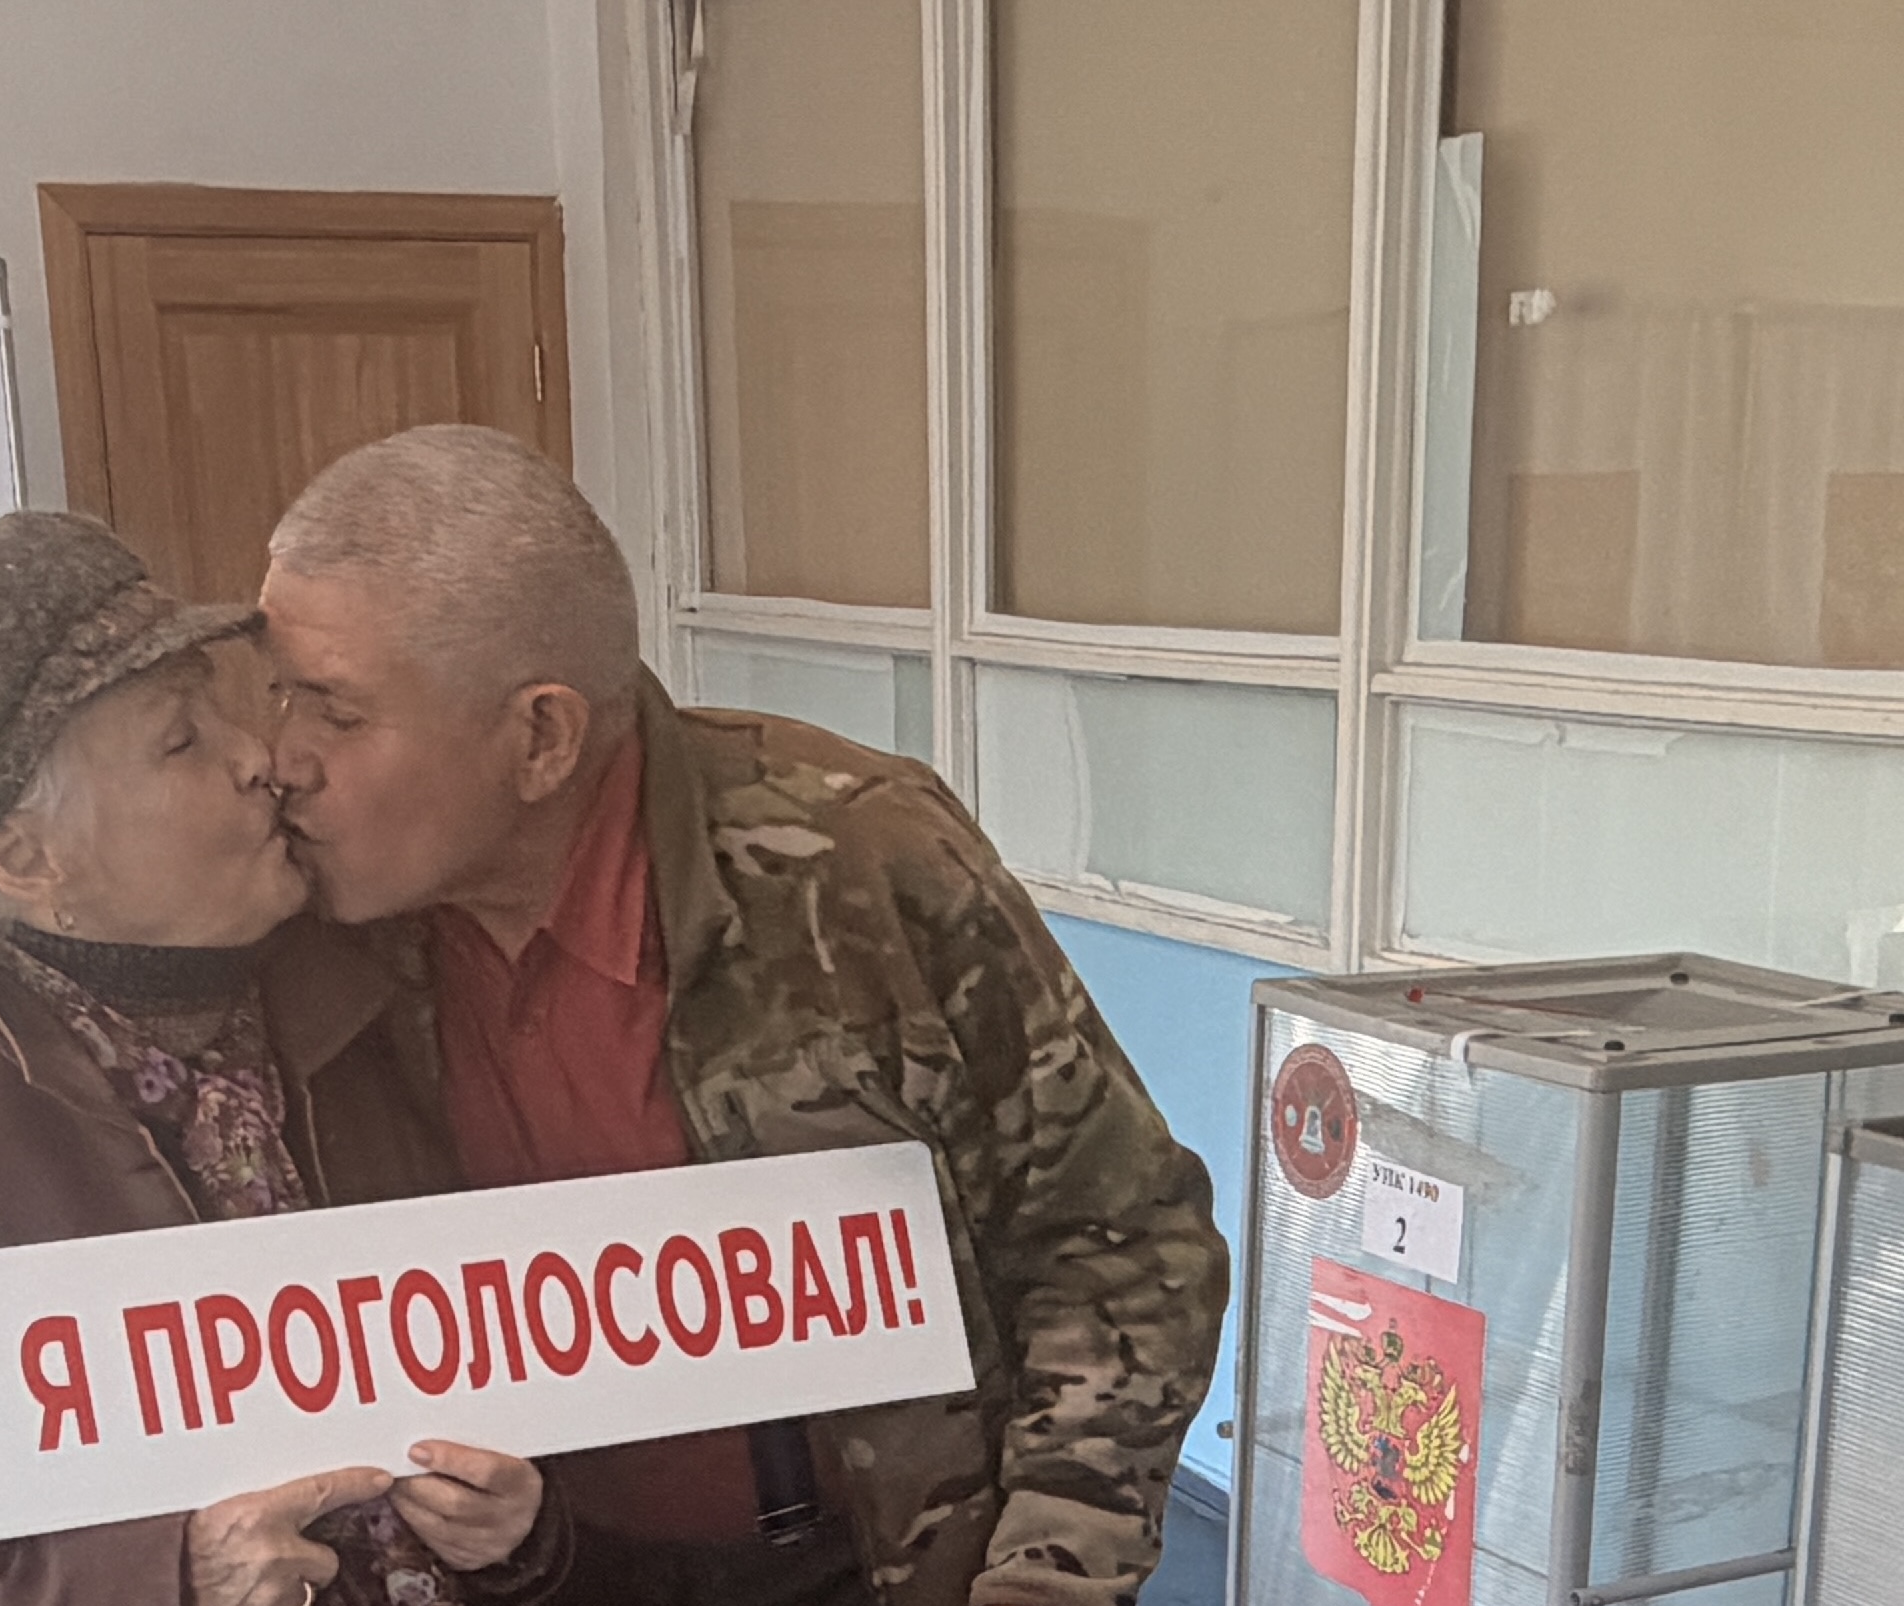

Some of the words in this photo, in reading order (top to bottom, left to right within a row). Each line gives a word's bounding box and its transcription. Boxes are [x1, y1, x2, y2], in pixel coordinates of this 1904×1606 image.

[1392, 1215, 1407, 1255] 2
[21, 1315, 99, 1452] Я
[123, 1208, 926, 1437] ПРОГОЛОСОВАЛ!
